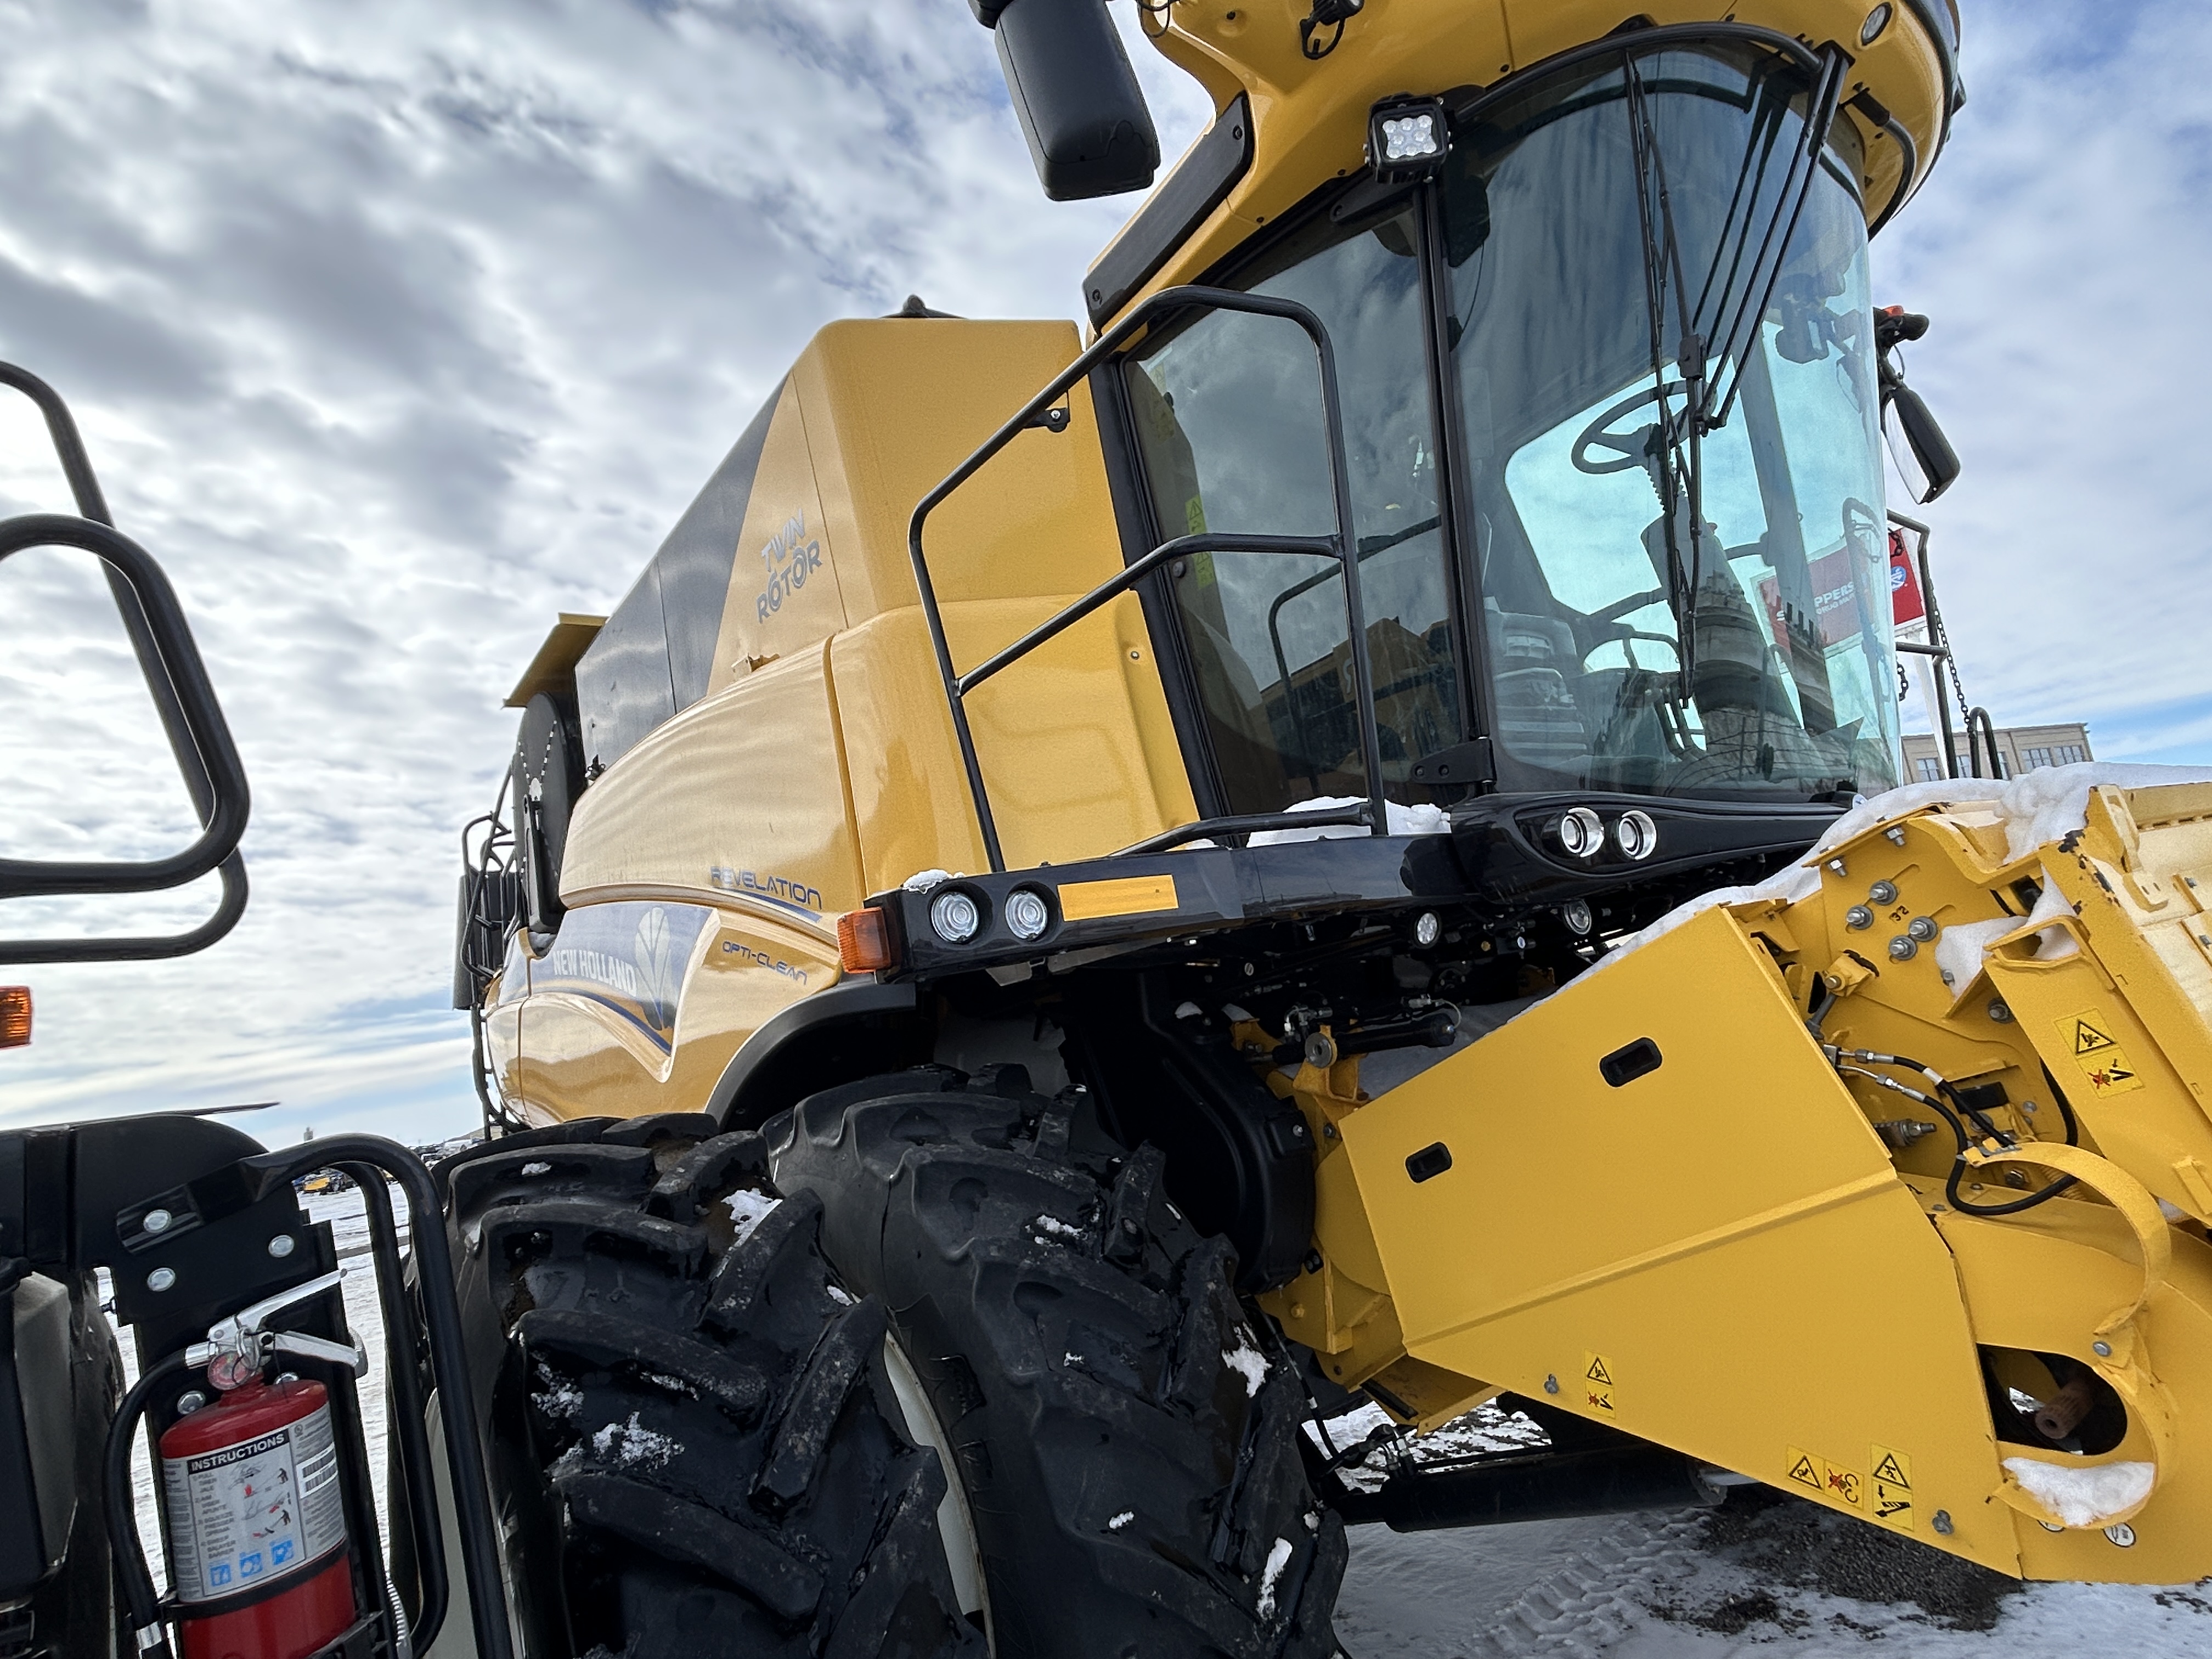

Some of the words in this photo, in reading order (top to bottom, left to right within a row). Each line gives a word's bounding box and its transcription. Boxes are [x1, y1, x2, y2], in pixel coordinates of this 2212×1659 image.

[761, 506, 805, 572] TWIN
[756, 540, 823, 624] ROTOR
[710, 866, 822, 910] REVELATION
[552, 949, 577, 975] NEW
[579, 949, 636, 997] HOLLAND
[722, 940, 808, 985] OPTI-CLEAN
[192, 1433, 285, 1471] INSTRUCTIONS
